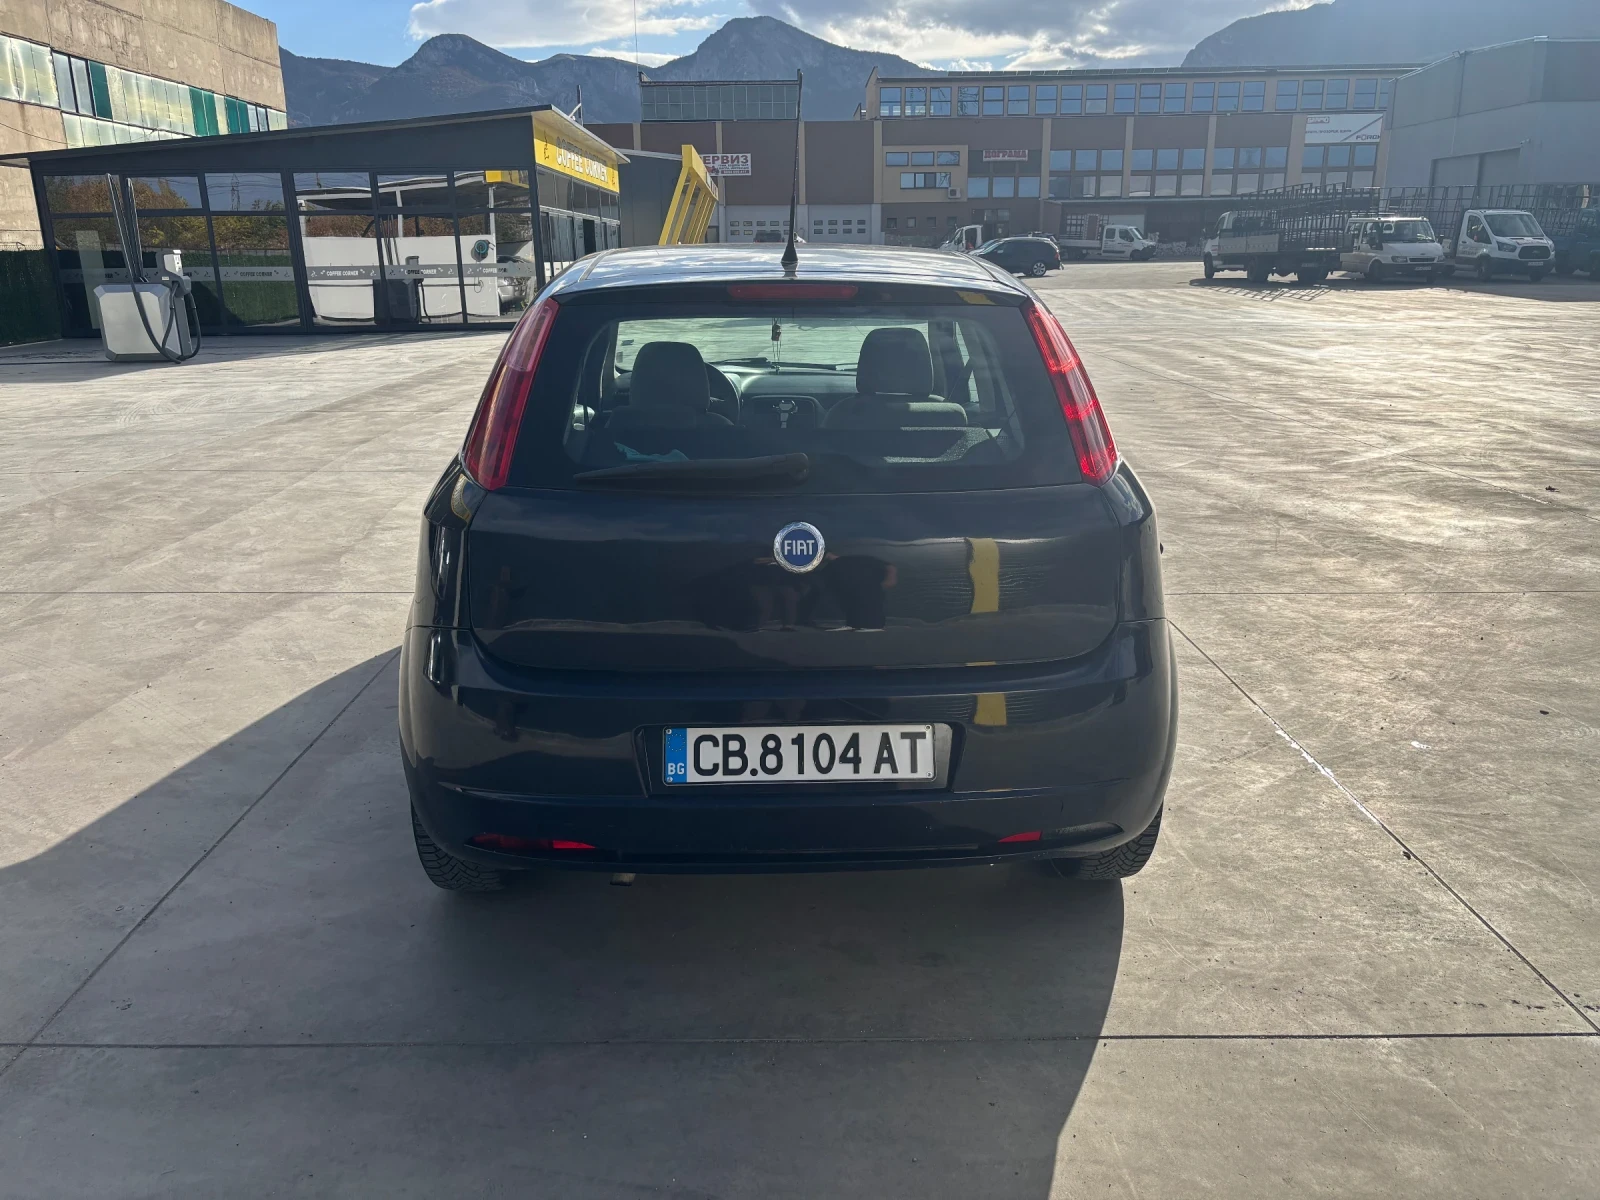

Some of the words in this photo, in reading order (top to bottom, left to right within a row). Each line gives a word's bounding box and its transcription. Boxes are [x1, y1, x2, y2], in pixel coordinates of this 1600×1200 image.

[556, 137, 584, 174] COFFEE
[584, 151, 608, 183] CORNER
[700, 155, 749, 165] ЕРВИЗ
[784, 539, 815, 556] FIAT
[667, 762, 685, 775] BG
